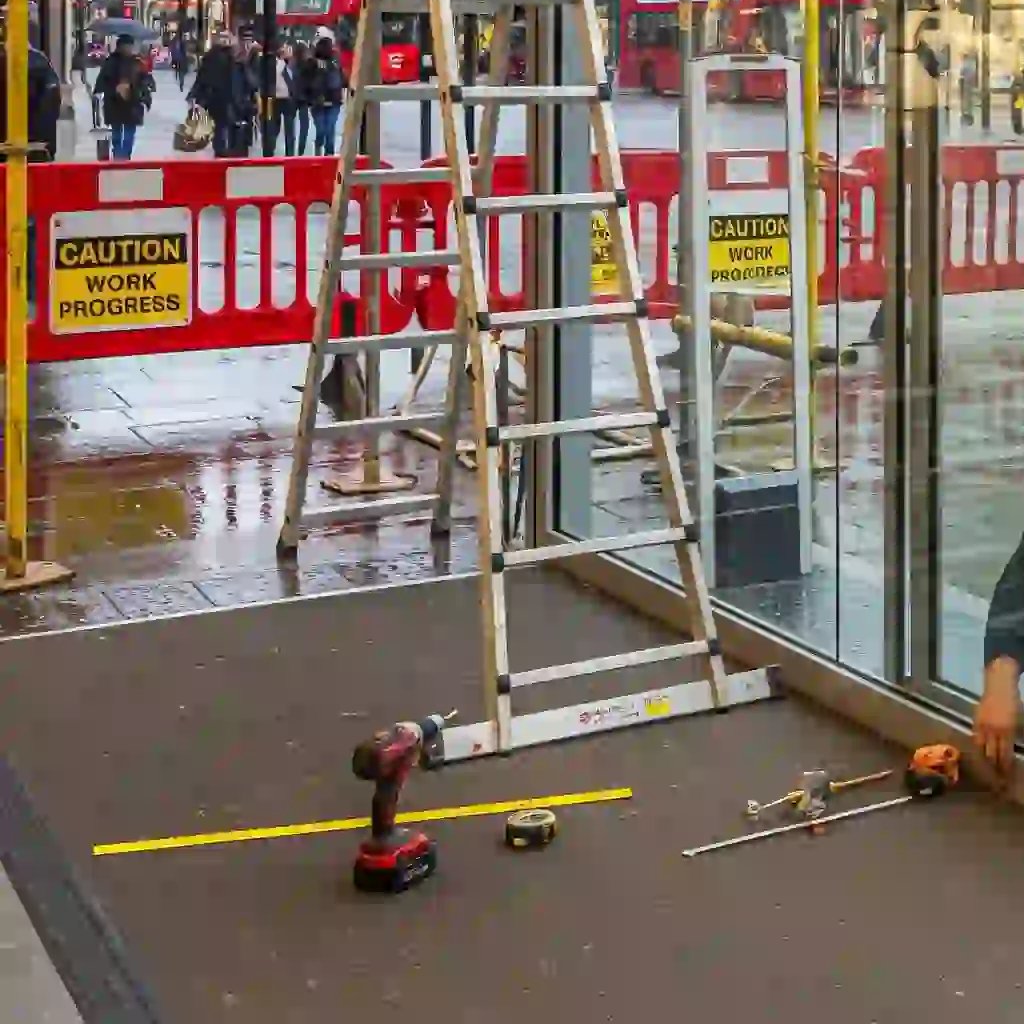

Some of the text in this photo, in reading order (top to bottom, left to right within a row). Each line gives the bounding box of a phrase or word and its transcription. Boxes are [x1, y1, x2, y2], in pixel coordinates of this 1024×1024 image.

[710, 217, 789, 238] CAUTION
[59, 238, 181, 266] CAUTION
[728, 245, 773, 263] WORK
[85, 271, 157, 293] WORK
[59, 294, 180, 319] PROGRESS
